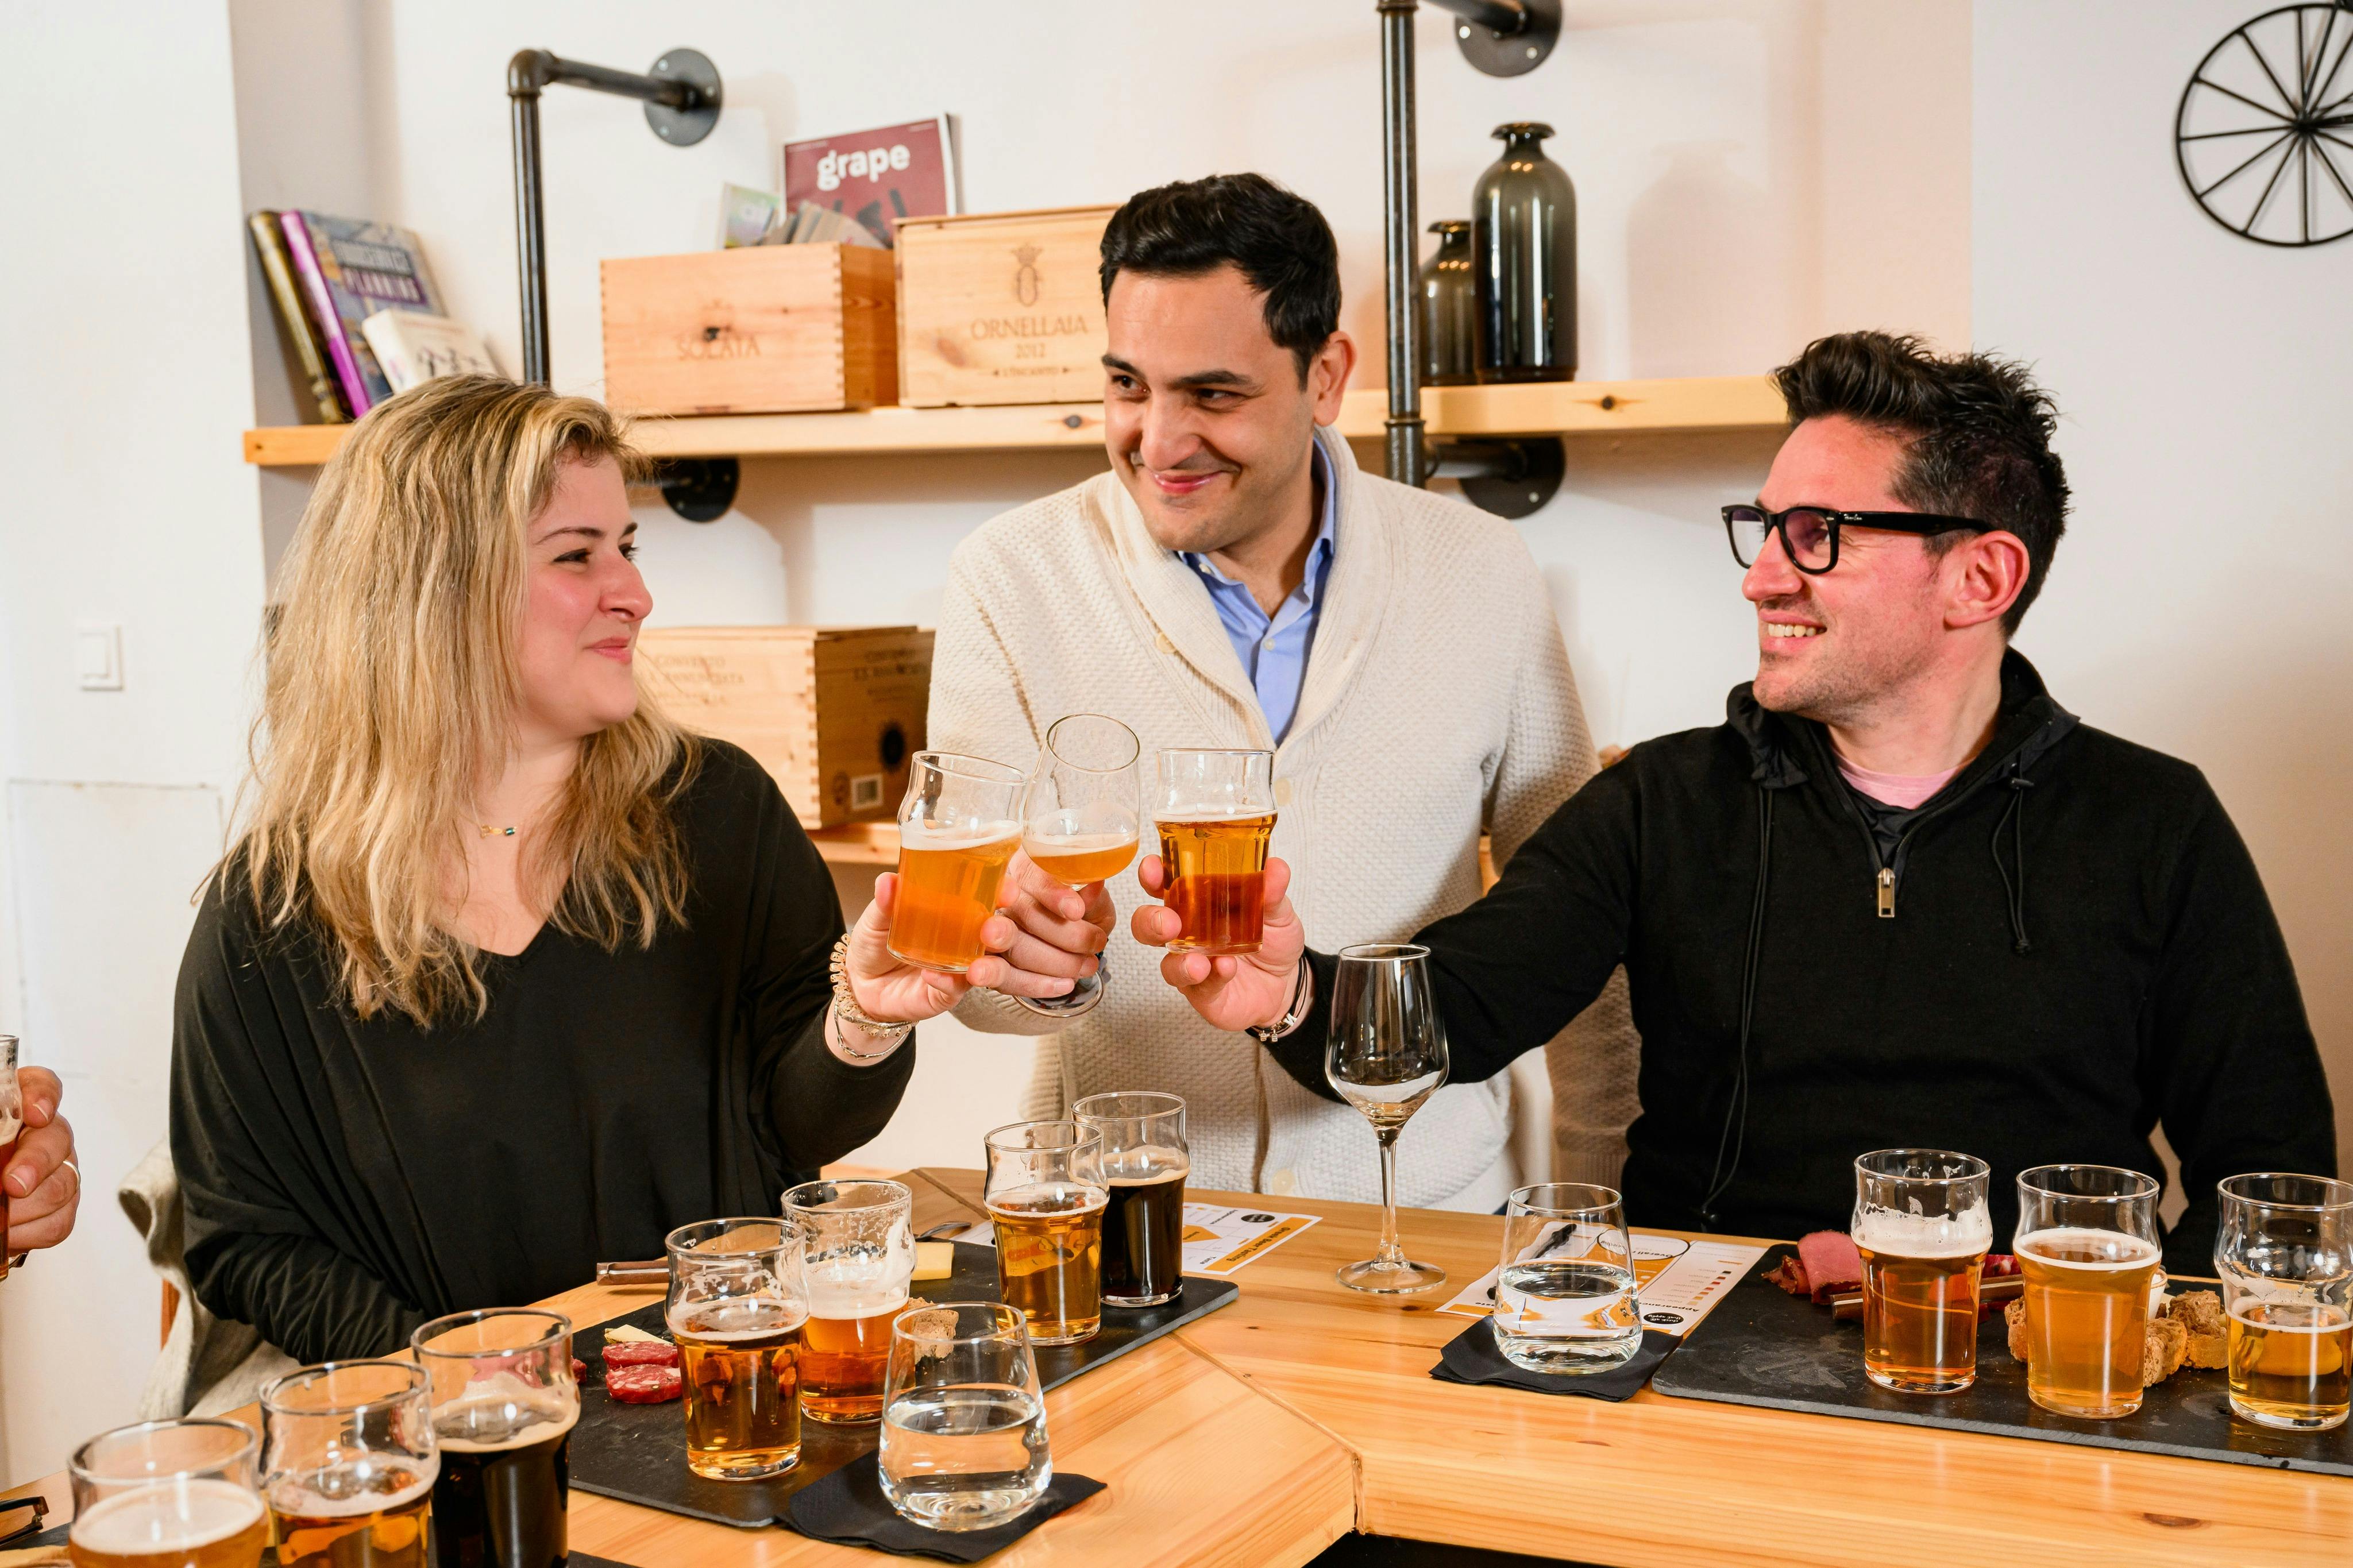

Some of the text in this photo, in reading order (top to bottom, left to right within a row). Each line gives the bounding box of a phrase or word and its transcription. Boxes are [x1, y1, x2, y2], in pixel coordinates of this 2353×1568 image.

[817, 144, 911, 191] grape
[970, 314, 1089, 341] ORNELLAIA
[1016, 343, 1046, 360] 2012
[1270, 1227, 1291, 1239] Greek
[1255, 1237, 1272, 1248] Beer
[1199, 1256, 1217, 1265] Taste
[1226, 1246, 1257, 1262] Tasting
